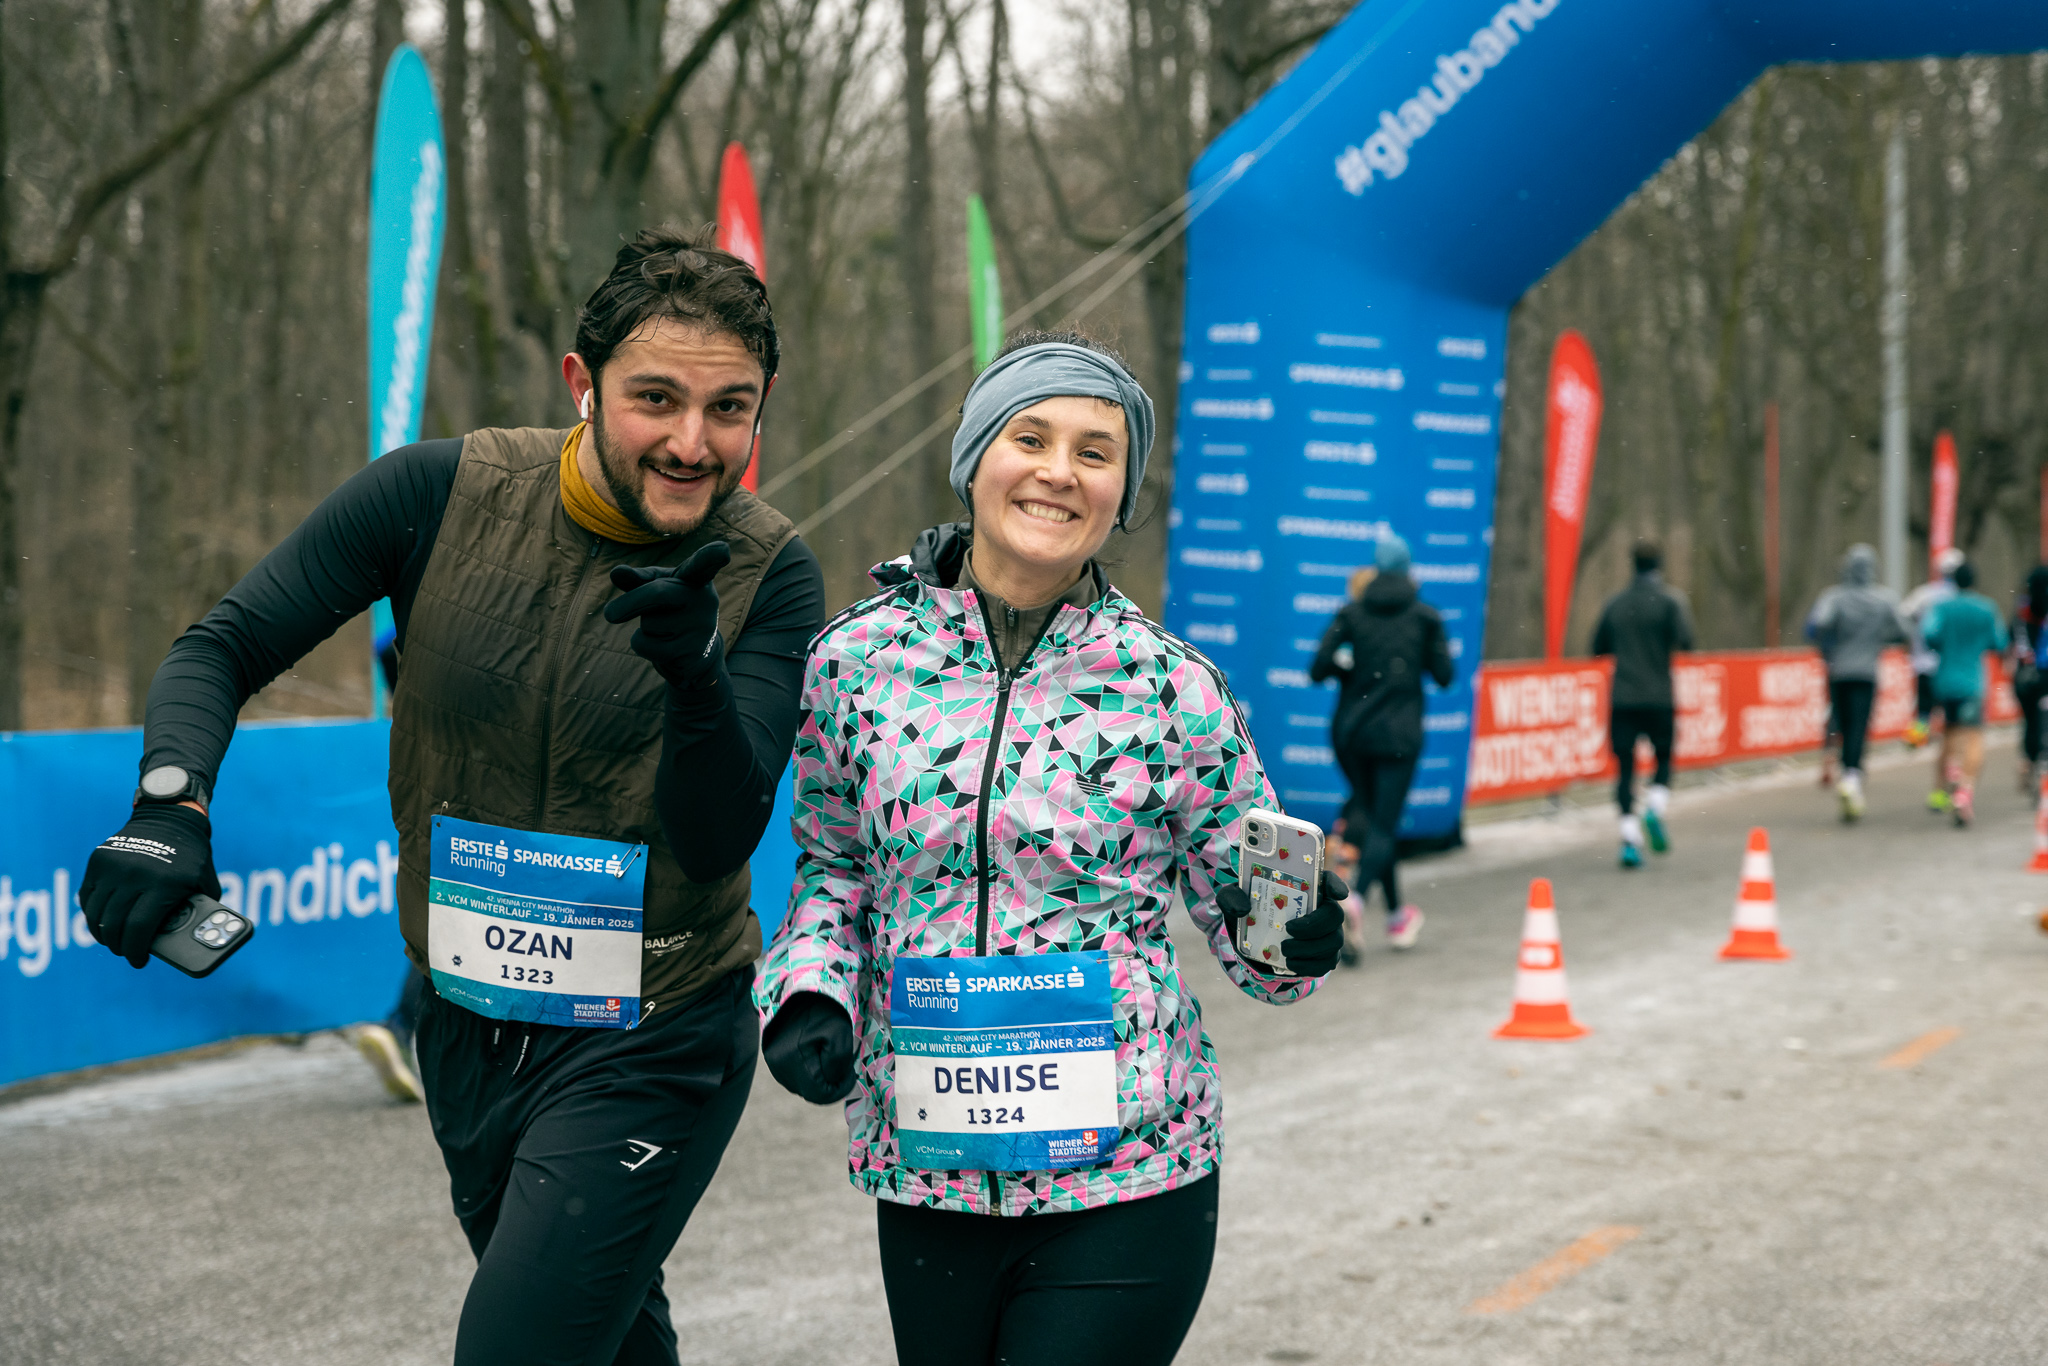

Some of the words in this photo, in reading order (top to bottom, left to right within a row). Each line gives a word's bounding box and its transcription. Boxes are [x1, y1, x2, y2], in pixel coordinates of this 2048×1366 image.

[127, 837, 177, 855] NORMAL
[451, 837, 493, 857] ERSTE
[513, 849, 604, 873] SPARKASSE
[451, 852, 506, 877] Running
[436, 892, 445, 901] 2.
[447, 894, 468, 906] VCM
[470, 899, 532, 918] WINTERLAUF
[543, 912, 558, 924] 19.
[561, 914, 605, 927] JÄNNER
[608, 918, 634, 929] 2025
[497, 897, 521, 907] VIENNA
[522, 901, 536, 909] CITY
[537, 903, 575, 915] MARATHON
[485, 925, 573, 961] OZAN
[500, 964, 554, 985] 1323
[906, 977, 945, 993] ERSTE
[966, 973, 1066, 993] SPARKASSE
[573, 1003, 606, 1011] WIENER
[908, 993, 959, 1013] Running
[900, 1042, 909, 1051] 2.
[910, 1042, 927, 1052] VCM
[929, 1042, 993, 1054] WINTERLAUF
[1006, 1041, 1023, 1052] 19.
[1026, 1037, 1074, 1050] JÄNNER
[1077, 1037, 1105, 1048] 2025
[954, 1034, 980, 1043] VIENNA
[980, 1033, 997, 1042] CITY
[998, 1031, 1041, 1040] MARATHON
[934, 1063, 1059, 1094] DENISE
[967, 1107, 1025, 1125] 1324
[915, 1145, 935, 1154] VCM
[1048, 1139, 1083, 1149] WIENER
